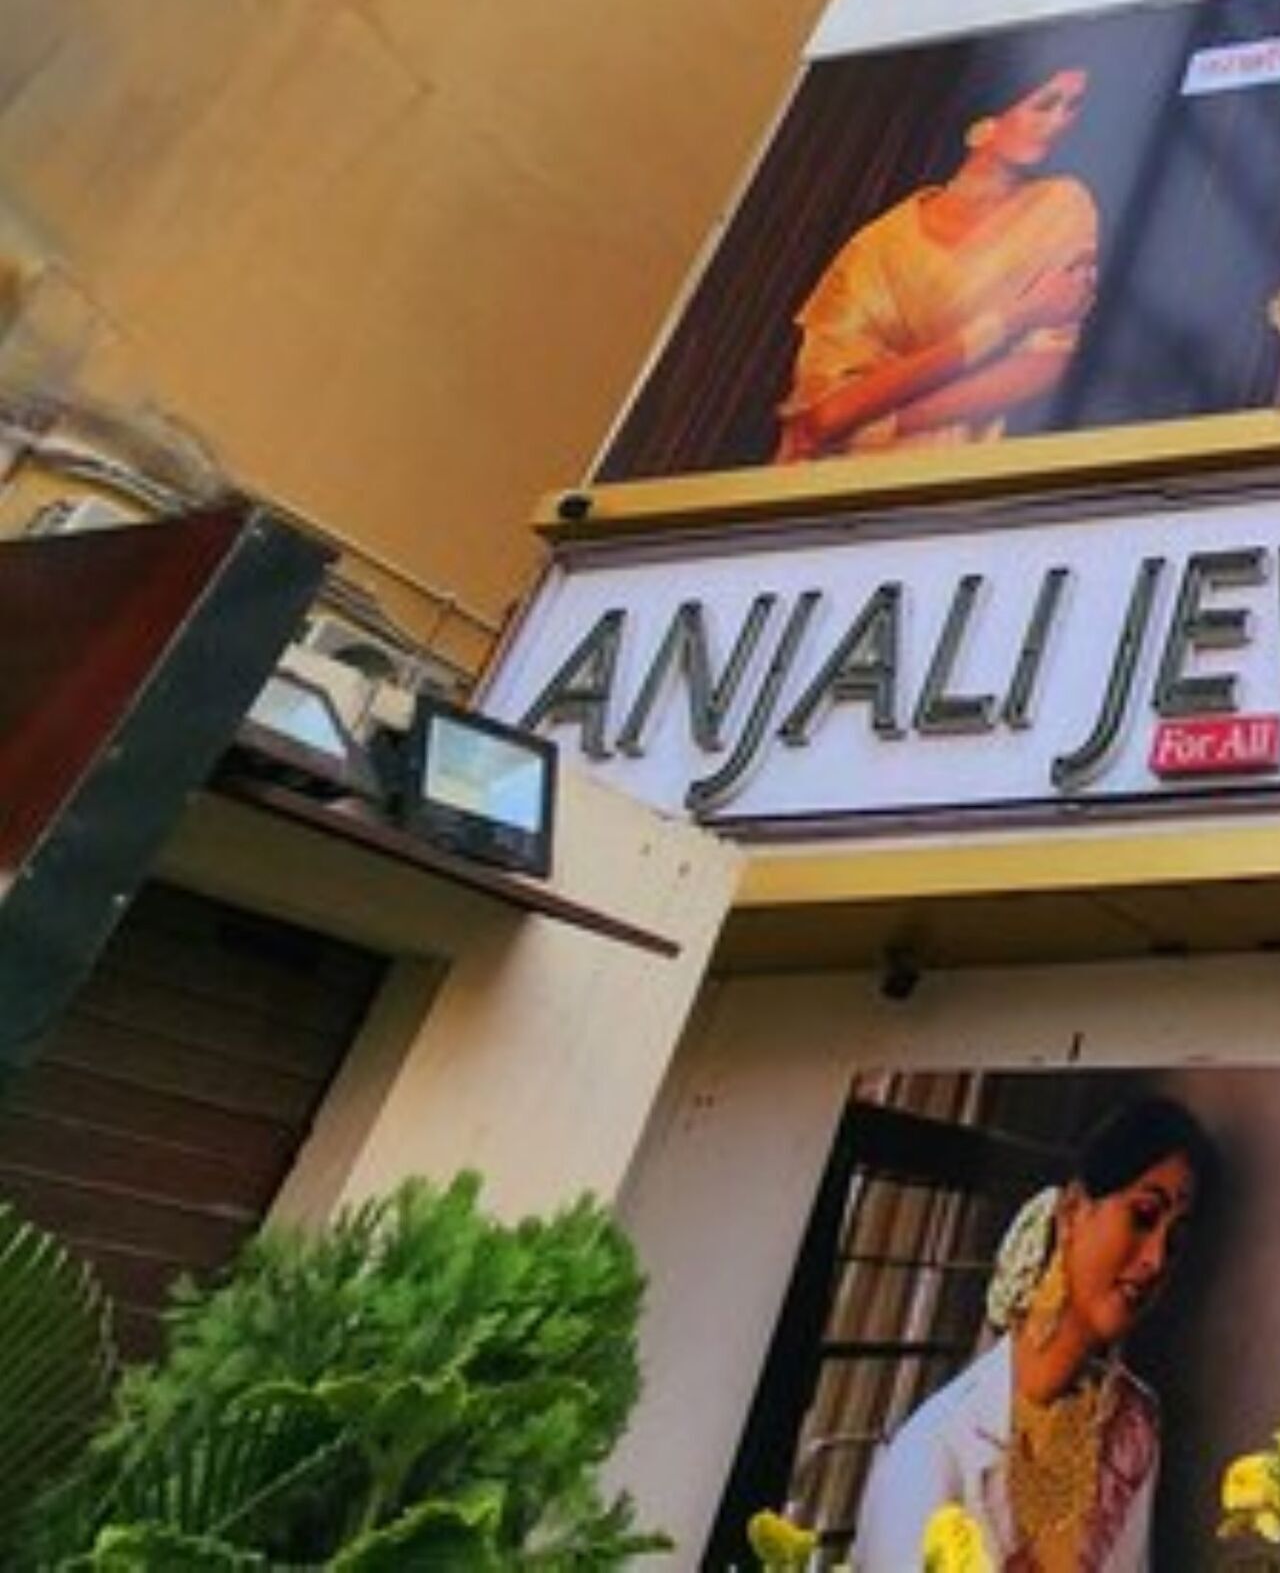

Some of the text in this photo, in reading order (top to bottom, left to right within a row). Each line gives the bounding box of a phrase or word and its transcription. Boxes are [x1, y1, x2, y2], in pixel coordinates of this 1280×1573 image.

[519, 567, 1069, 814] ANJALI
[1158, 723, 1270, 763] For All
